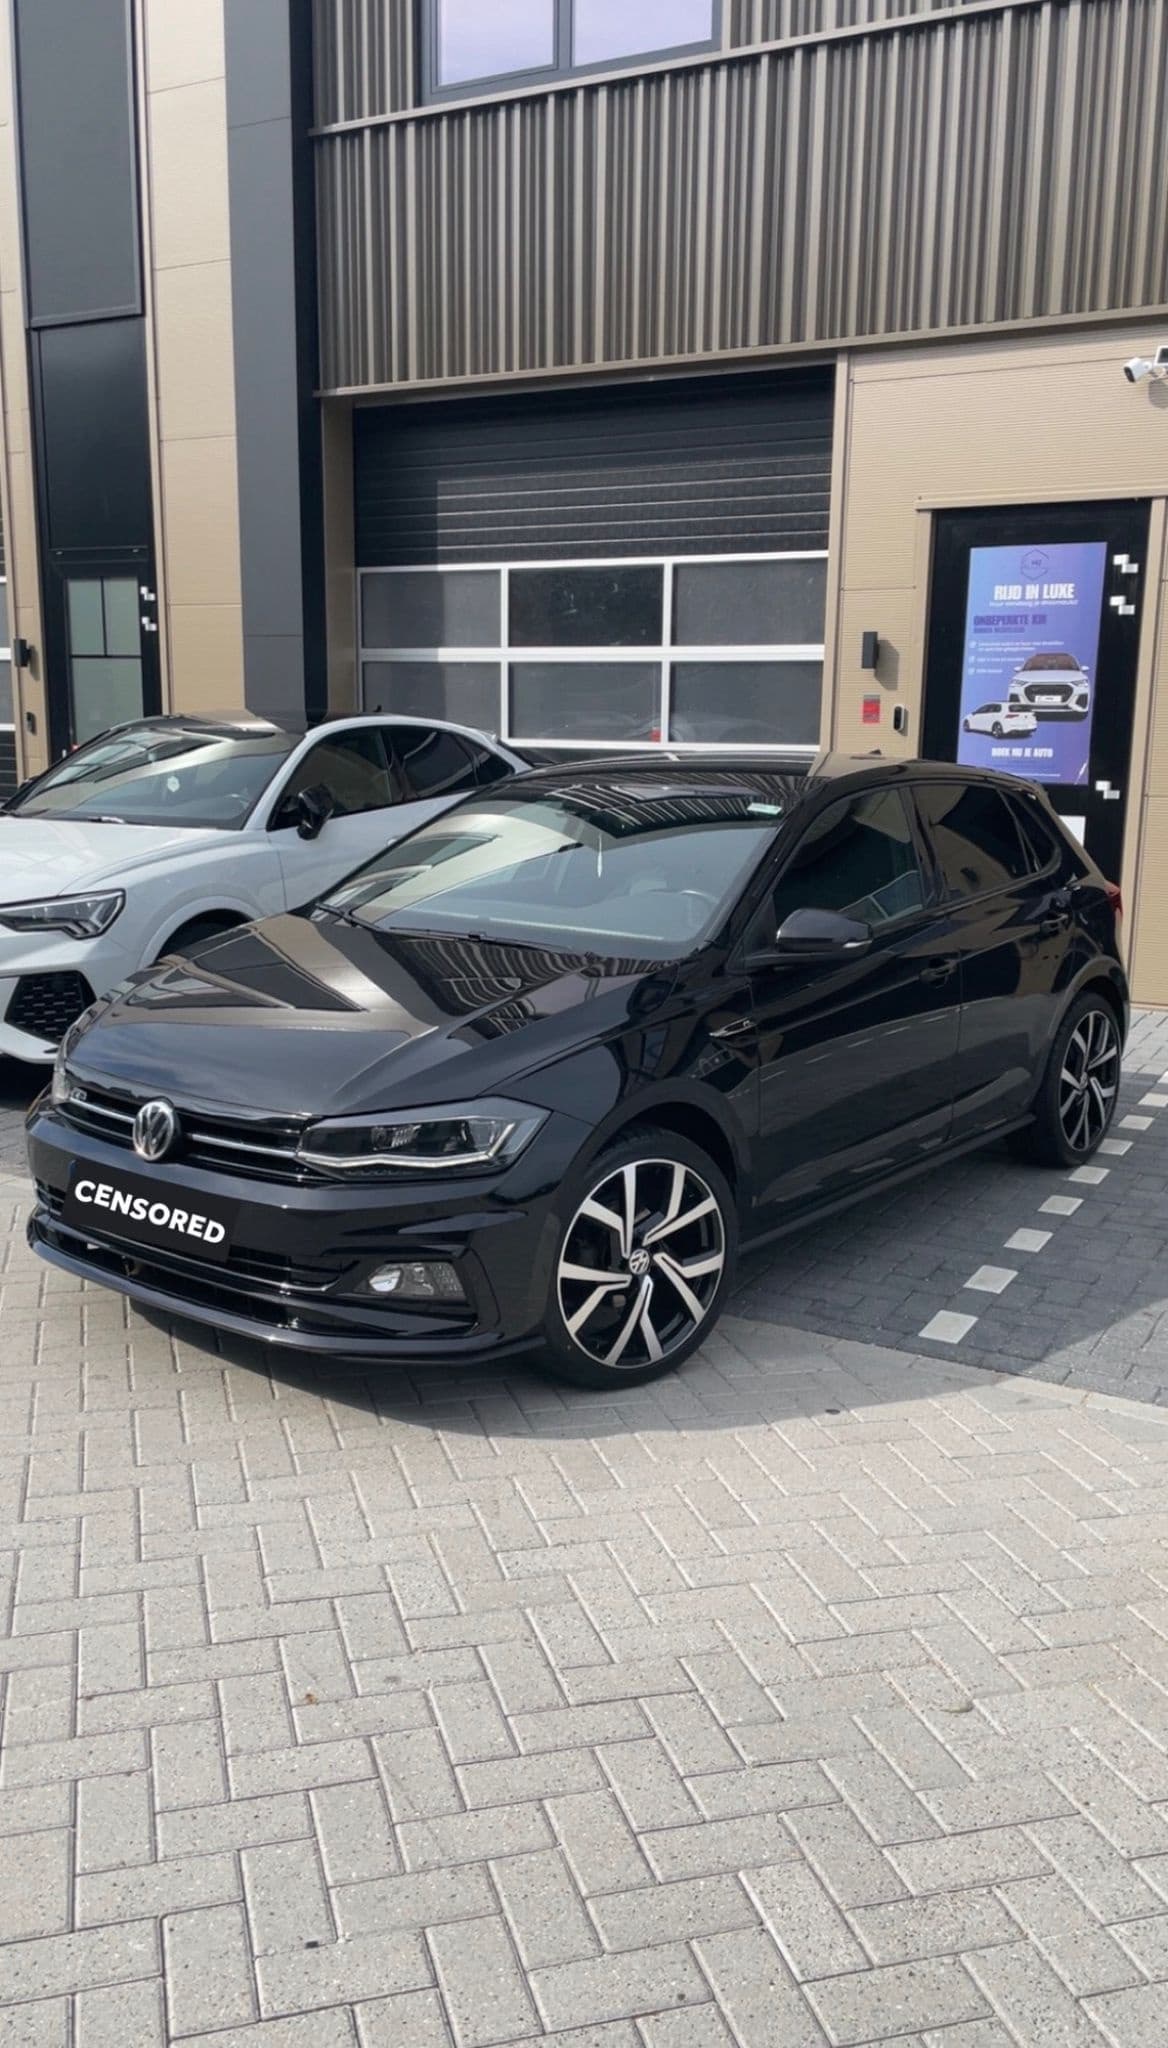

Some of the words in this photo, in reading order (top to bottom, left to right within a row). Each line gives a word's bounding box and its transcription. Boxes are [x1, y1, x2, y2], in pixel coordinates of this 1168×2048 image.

[994, 585, 1022, 600] RIJD
[1025, 584, 1039, 600] IN
[1043, 583, 1075, 599] LUXE
